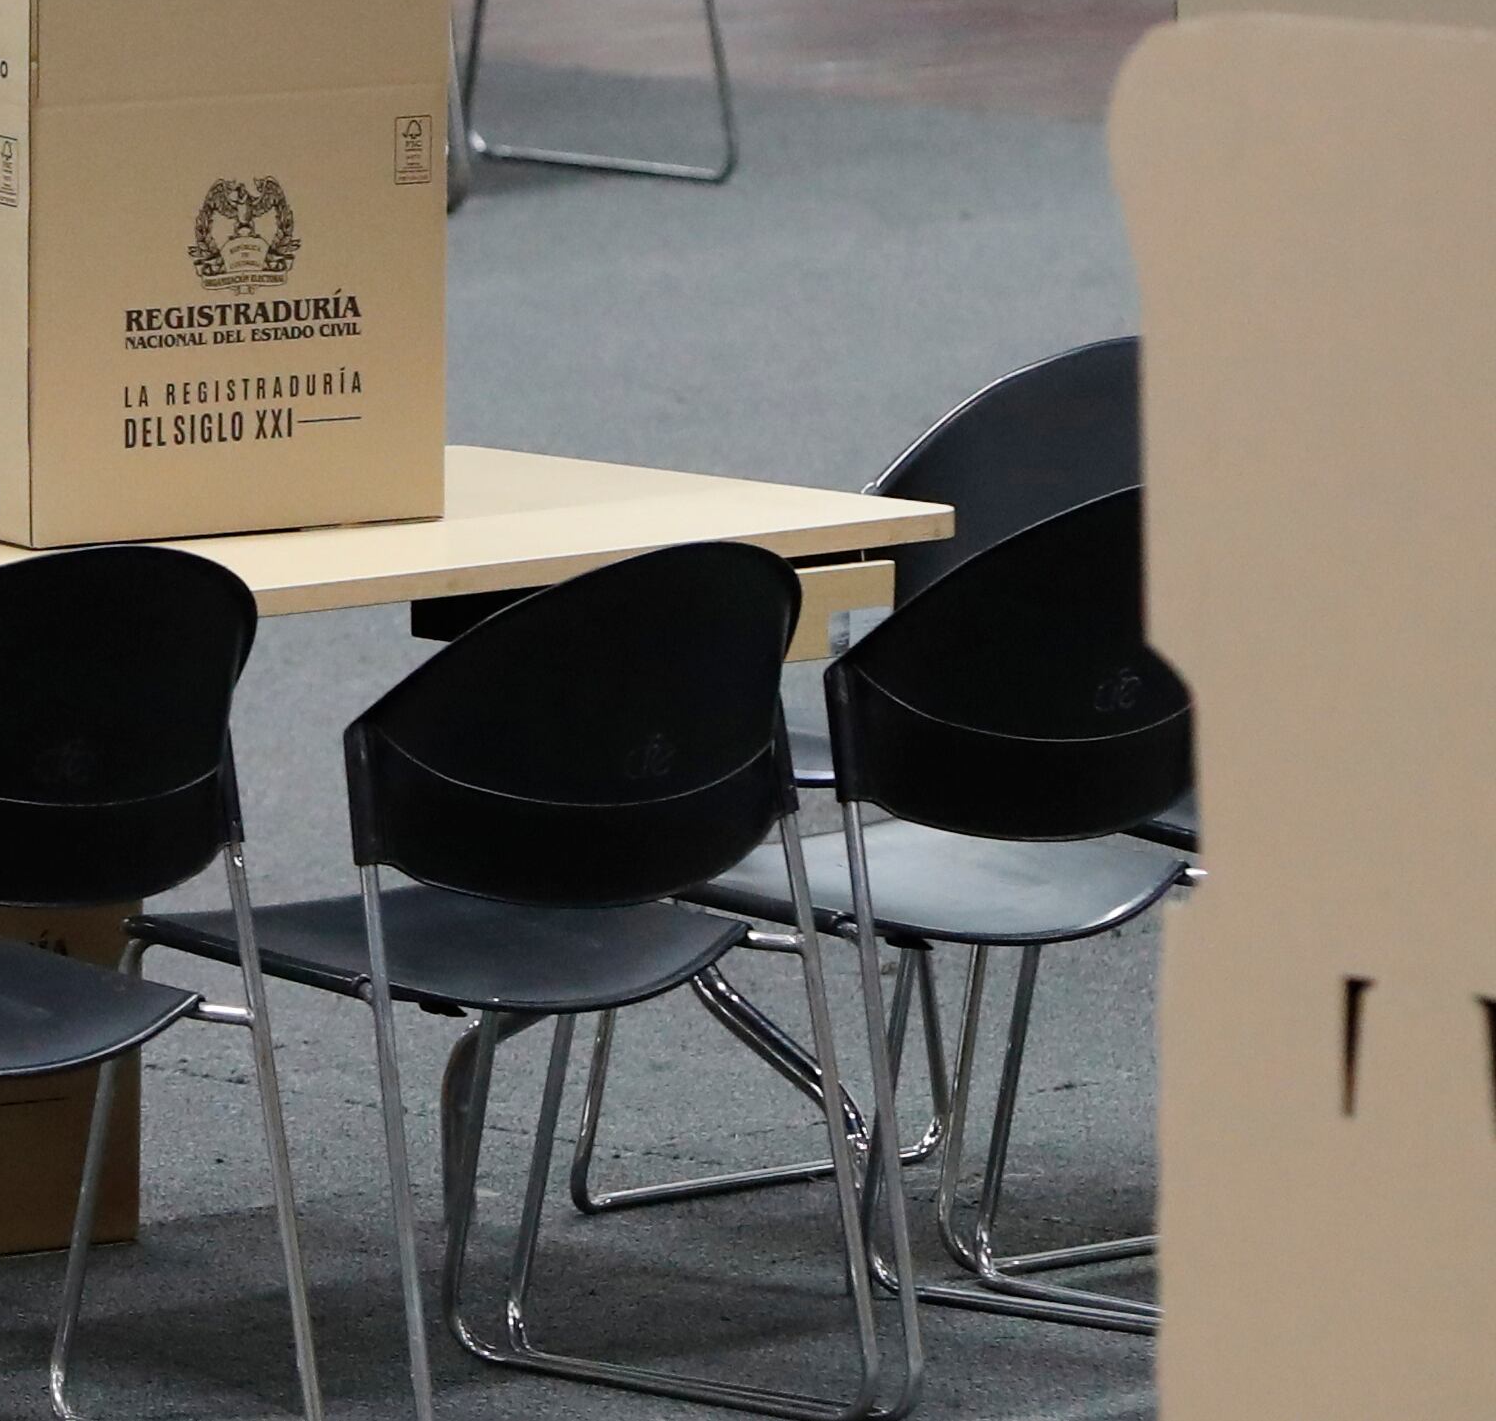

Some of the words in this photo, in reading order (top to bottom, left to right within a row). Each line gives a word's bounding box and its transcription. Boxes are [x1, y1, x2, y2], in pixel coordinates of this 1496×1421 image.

[125, 288, 361, 331] REGISTRADURÍA
[125, 332, 207, 350] NACIONAL
[213, 330, 245, 345] DEL
[251, 325, 314, 342] ESTADO
[319, 322, 361, 337] CIVIL
[125, 385, 149, 408] LA
[166, 366, 361, 406] REGISTRADURÍA
[255, 408, 293, 439] XXI
